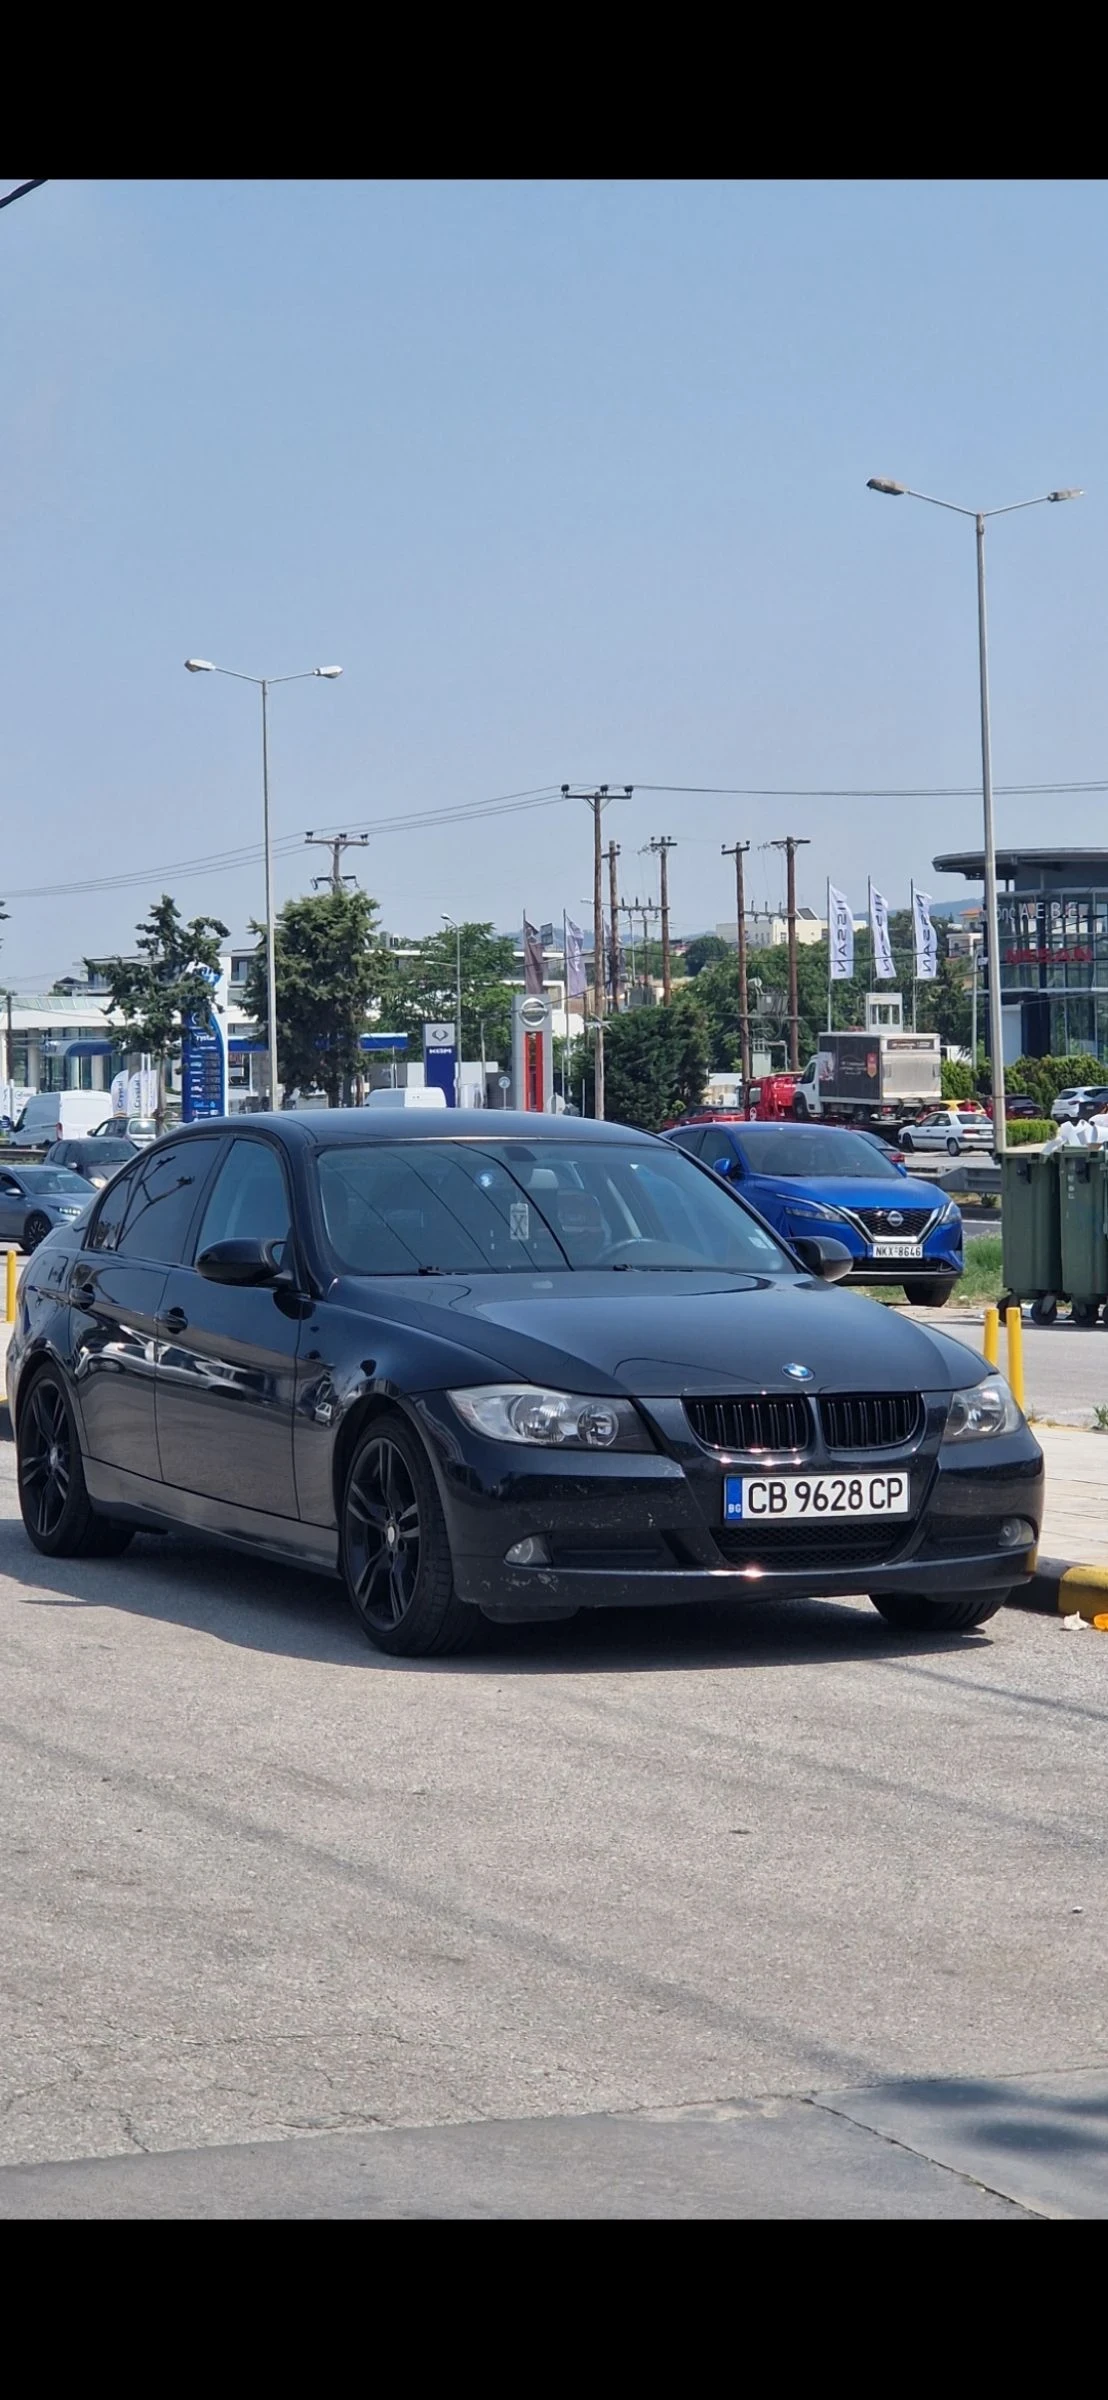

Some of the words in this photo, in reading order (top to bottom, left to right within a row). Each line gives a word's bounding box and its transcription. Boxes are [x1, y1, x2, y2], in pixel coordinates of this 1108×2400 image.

[748, 1481, 788, 1514] CB
[794, 1479, 863, 1513] 9628
[869, 1477, 903, 1510] CP
[728, 1503, 742, 1514] BG
